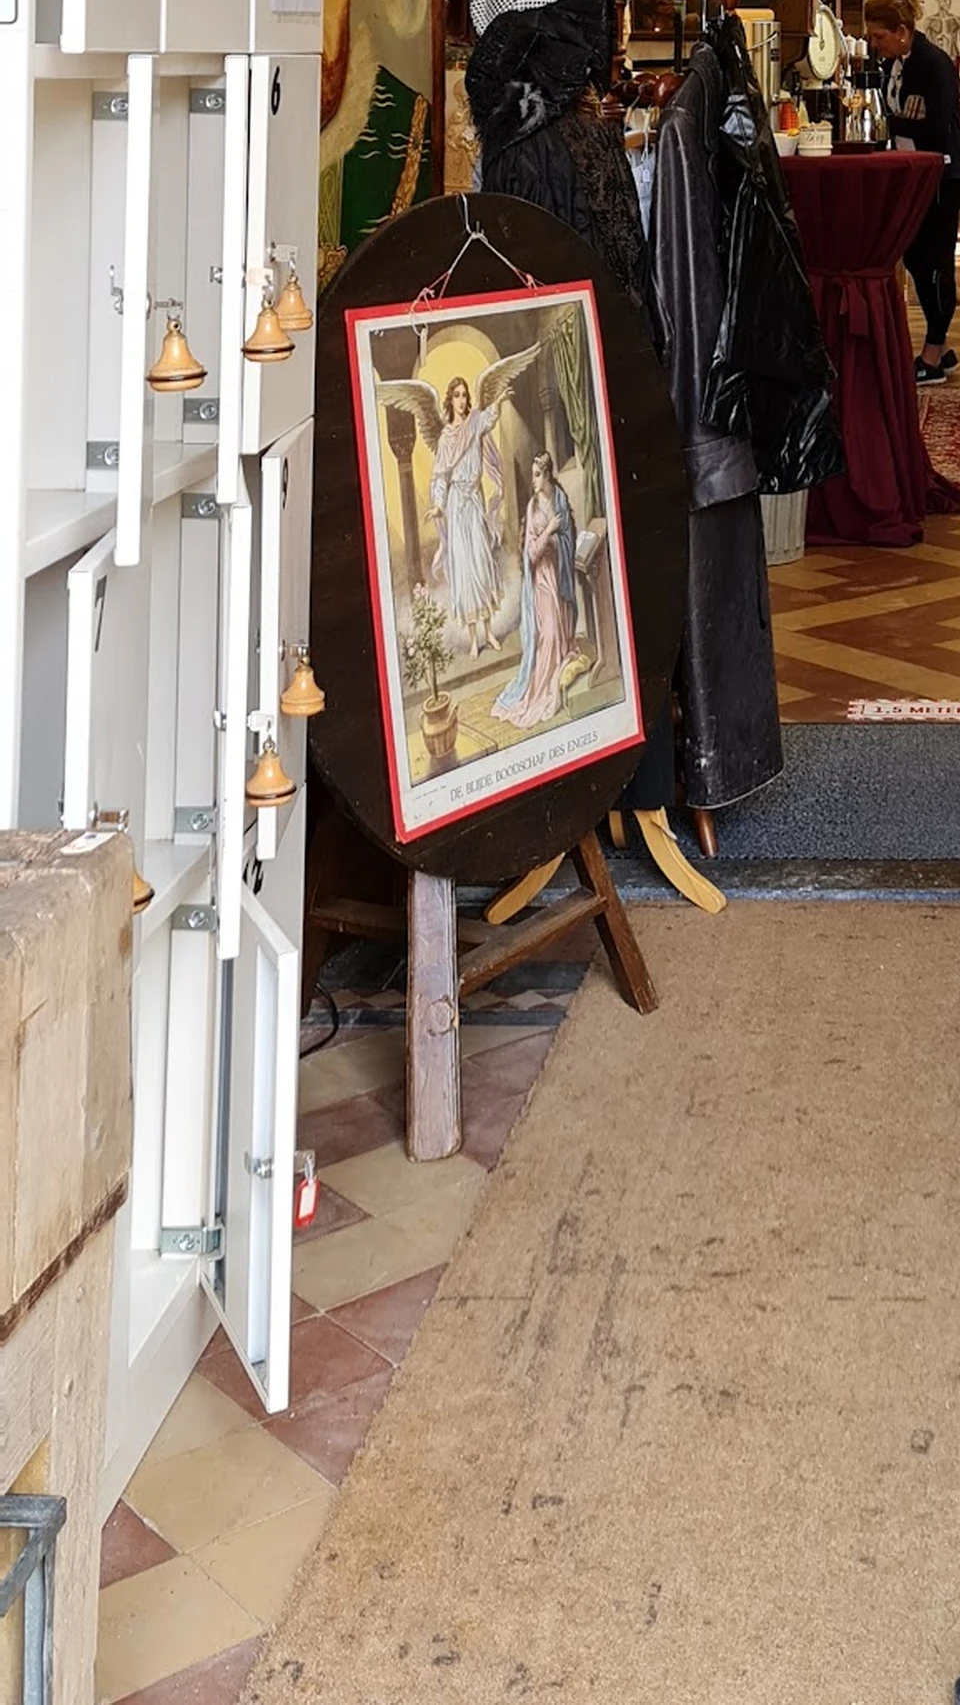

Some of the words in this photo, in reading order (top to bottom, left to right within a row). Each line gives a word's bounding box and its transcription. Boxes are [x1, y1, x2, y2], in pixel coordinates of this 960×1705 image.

[271, 65, 281, 116] 6
[282, 457, 289, 510] 9
[95, 575, 107, 653] 7
[450, 786, 464, 802] DE
[466, 774, 494, 795] BLIJDE
[496, 752, 546, 783] BOODSCHAP
[549, 744, 565, 760] DES
[567, 730, 599, 753] ENGELS
